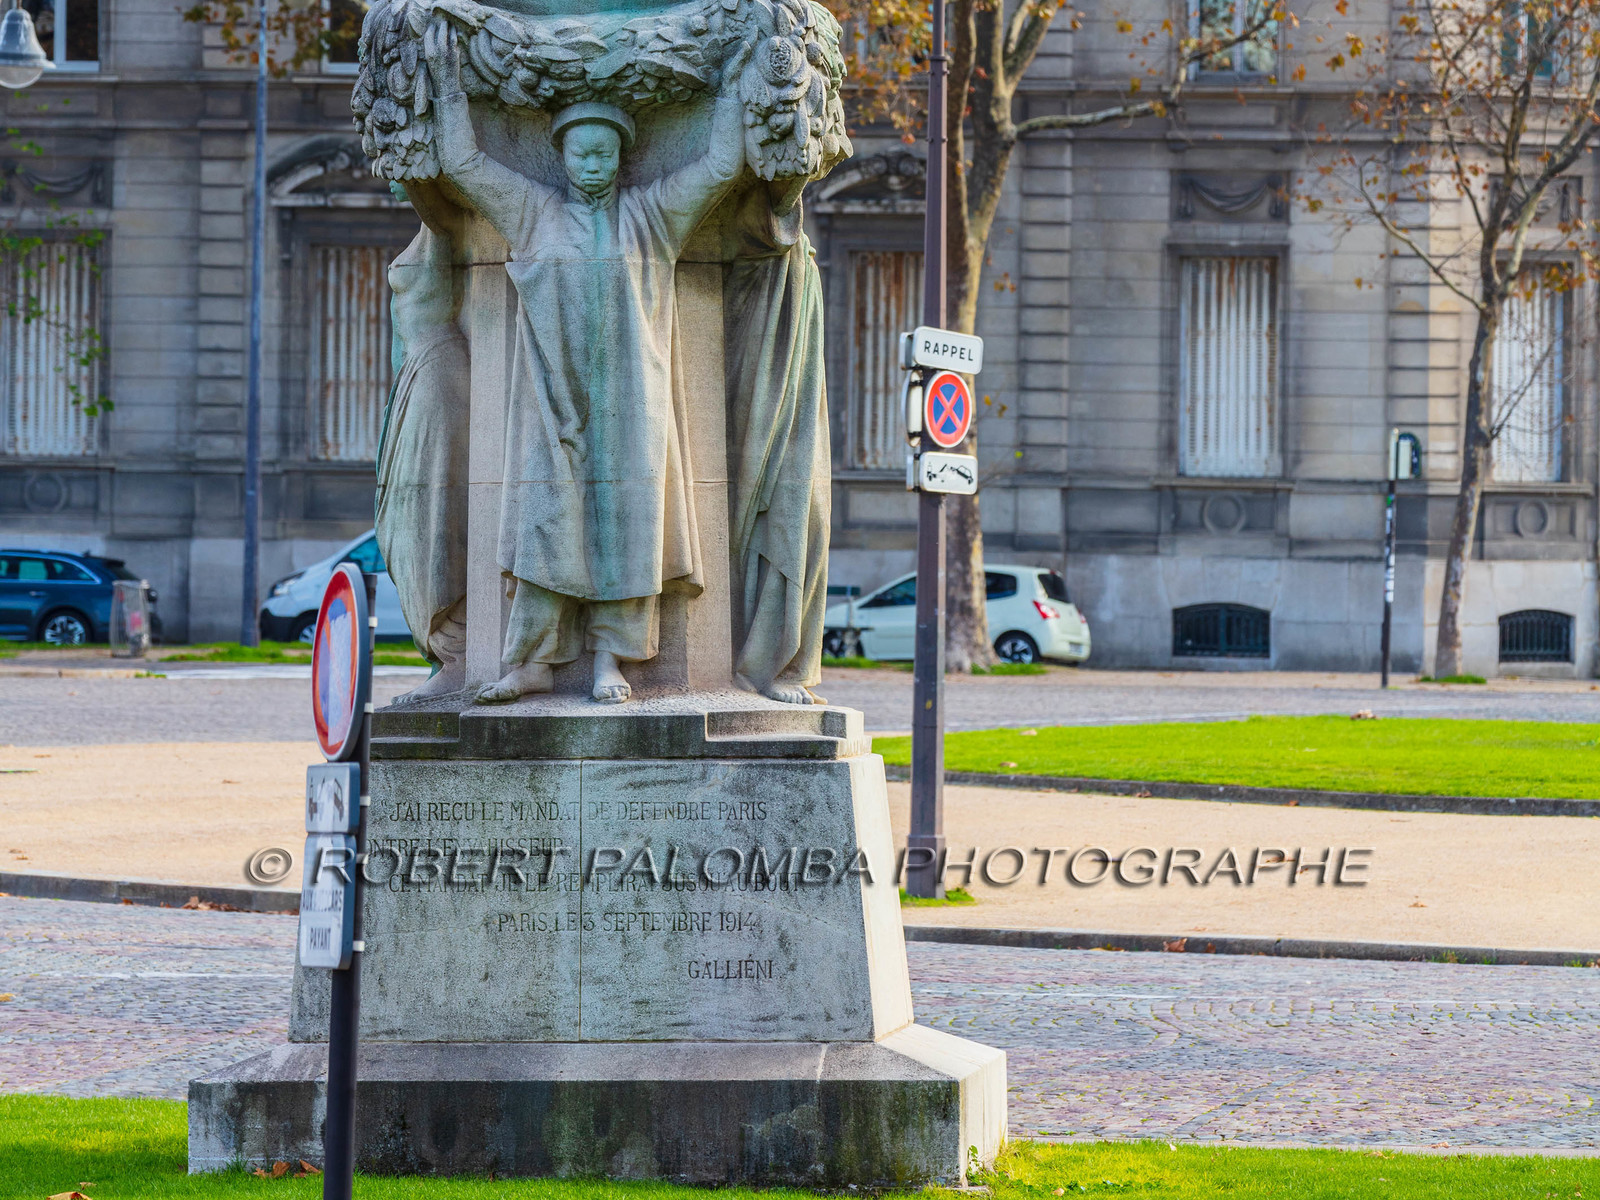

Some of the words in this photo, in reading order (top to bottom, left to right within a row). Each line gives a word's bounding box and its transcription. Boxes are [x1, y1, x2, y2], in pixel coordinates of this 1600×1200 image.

[924, 340, 974, 362] RAPPEL
[481, 801, 504, 821] LE
[510, 801, 579, 821] MANDAT
[588, 801, 610, 821] DE
[718, 801, 767, 821] PARIS
[389, 873, 411, 892] CE
[416, 873, 488, 893] MANDAT
[554, 911, 578, 931] LE
[583, 911, 595, 931] 3
[602, 911, 712, 932] SEPTEMBRE
